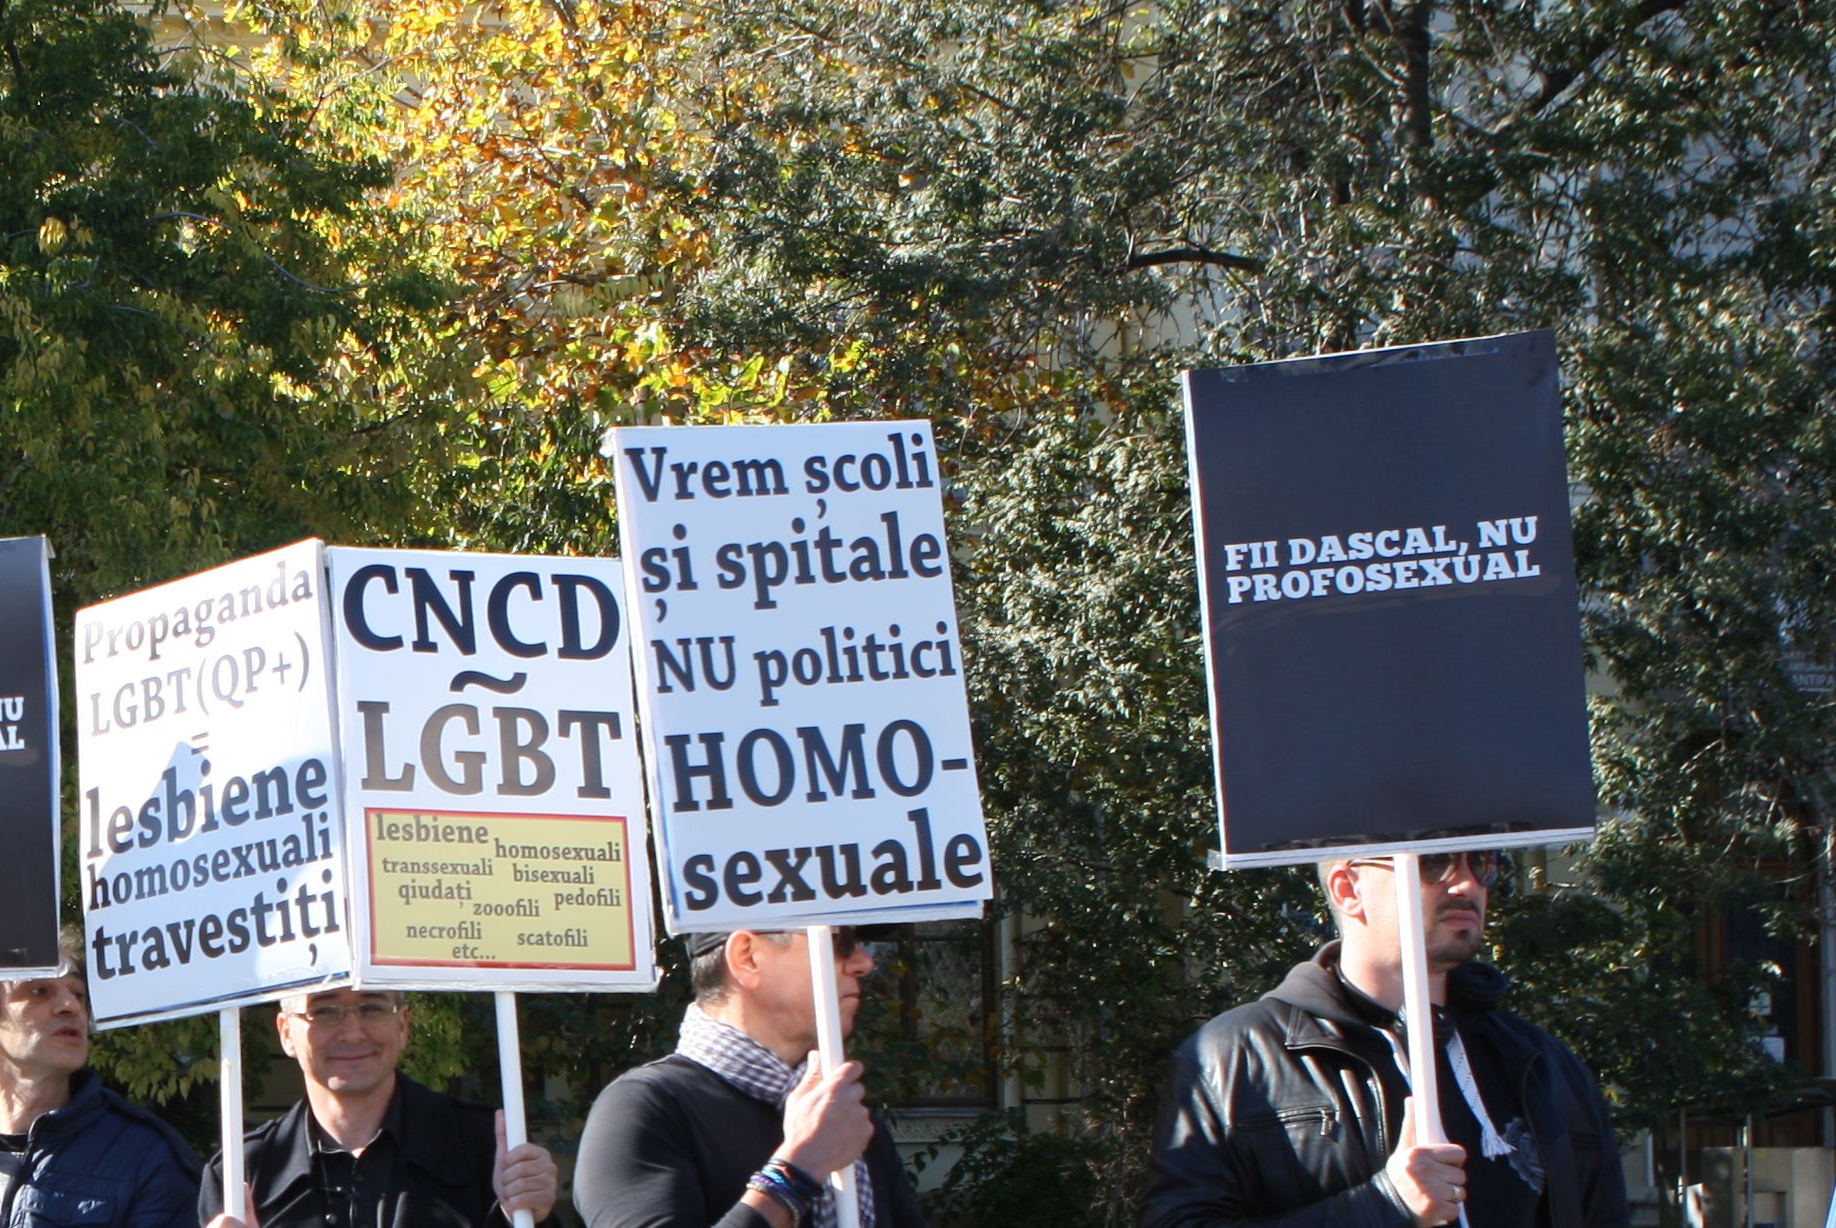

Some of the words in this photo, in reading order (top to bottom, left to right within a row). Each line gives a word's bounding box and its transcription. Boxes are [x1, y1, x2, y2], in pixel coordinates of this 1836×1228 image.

[625, 446, 789, 502] Vrem
[804, 432, 933, 518] școli
[640, 523, 698, 623] și
[716, 510, 942, 611] spitale
[1224, 540, 1279, 571] FII
[1288, 525, 1469, 566] DASCAL,
[1477, 516, 1538, 548] NU
[1227, 549, 1540, 604] PROFOSEXUAL
[82, 561, 313, 664] Propaganda
[343, 564, 620, 660] CNCD
[91, 631, 310, 737] LGBT(QP+)
[650, 635, 736, 694] NU
[753, 621, 956, 707] politici
[357, 701, 622, 799] LGBT
[664, 718, 968, 813] HOMO-
[86, 757, 328, 859] lesbiene
[375, 813, 489, 844] lesbiene
[494, 838, 621, 862] homosexuali
[87, 812, 333, 910] homosexuali
[382, 857, 493, 876] transsexuali
[513, 863, 595, 885] bisexuali
[554, 888, 621, 910] pedofili
[683, 807, 983, 912] sexuale
[92, 869, 340, 980] travestiți
[406, 921, 482, 940] necrofili
[473, 899, 540, 918] zooofili
[517, 929, 588, 947] scatofili
[452, 944, 496, 960] etc...
